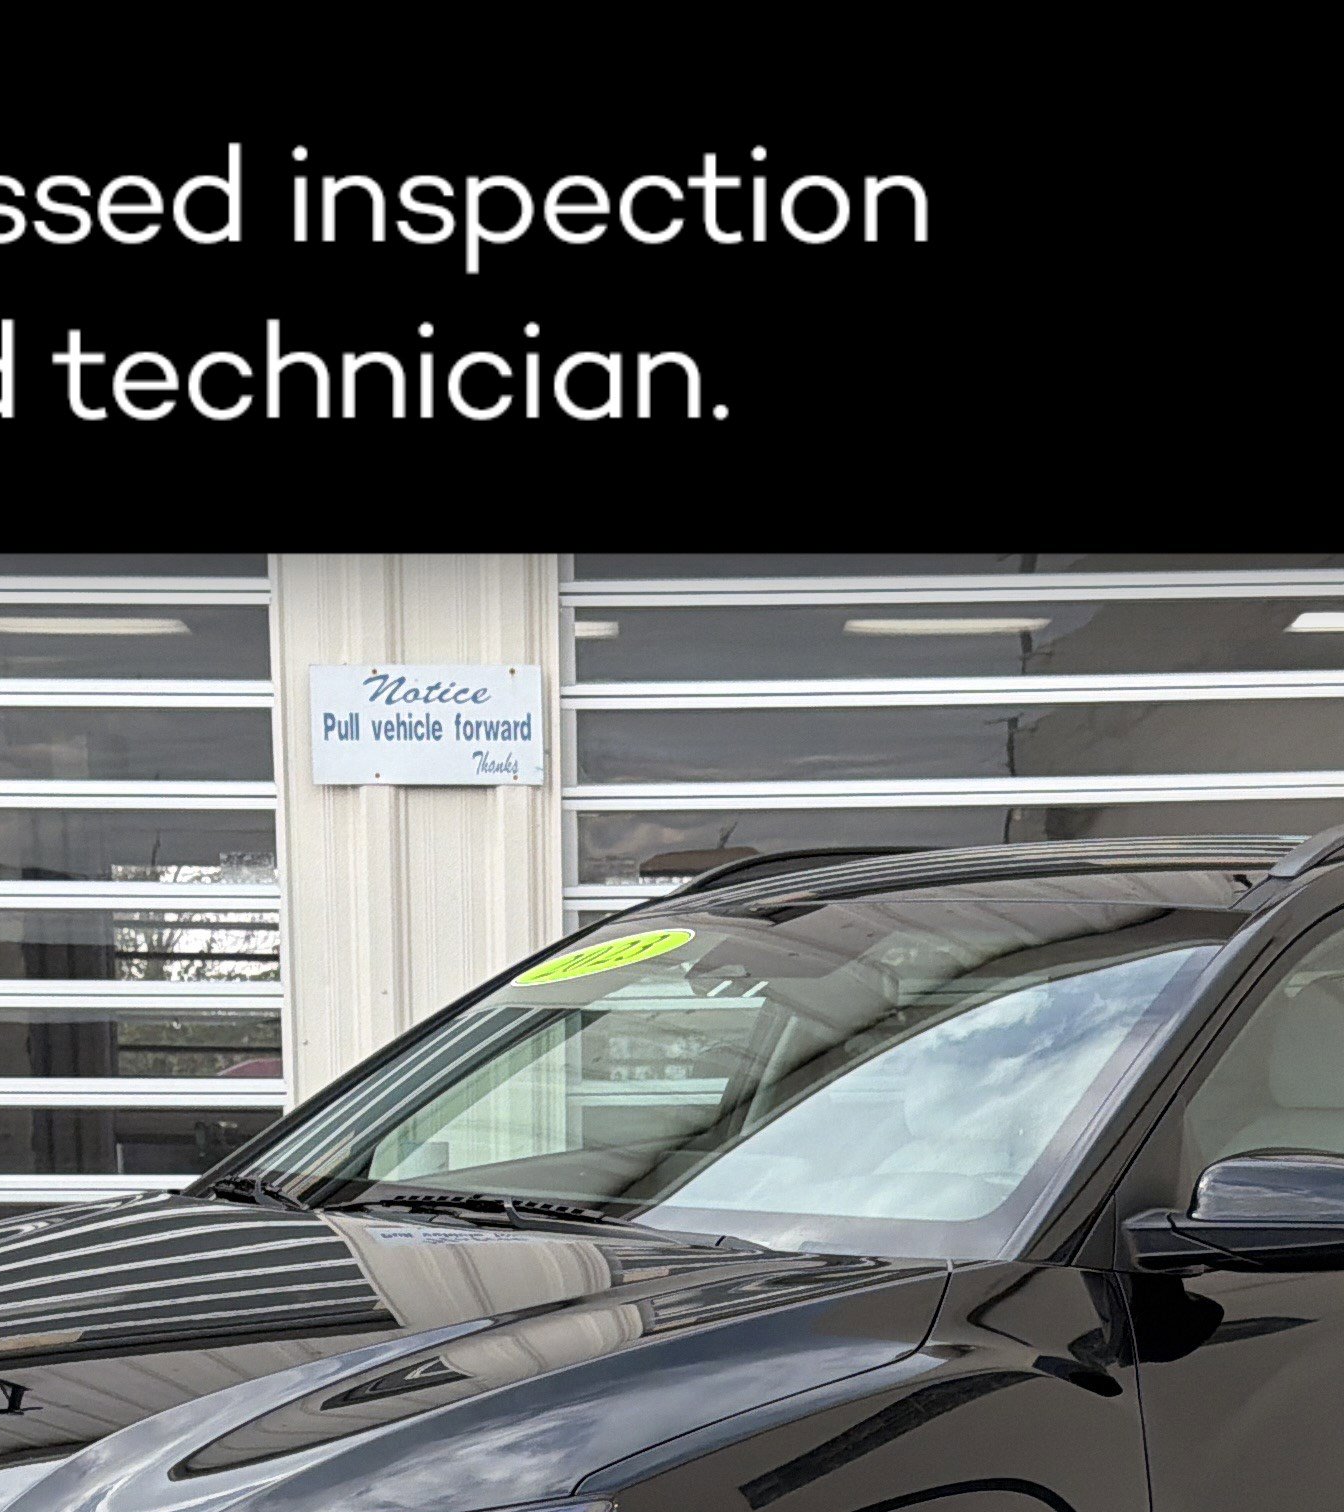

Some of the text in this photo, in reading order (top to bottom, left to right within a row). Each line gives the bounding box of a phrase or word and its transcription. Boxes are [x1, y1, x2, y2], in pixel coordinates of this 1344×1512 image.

[362, 674, 492, 705] Notice
[323, 712, 532, 741] Pull vehicle forward
[472, 750, 519, 776] Thanks
[530, 934, 670, 981] 2023
